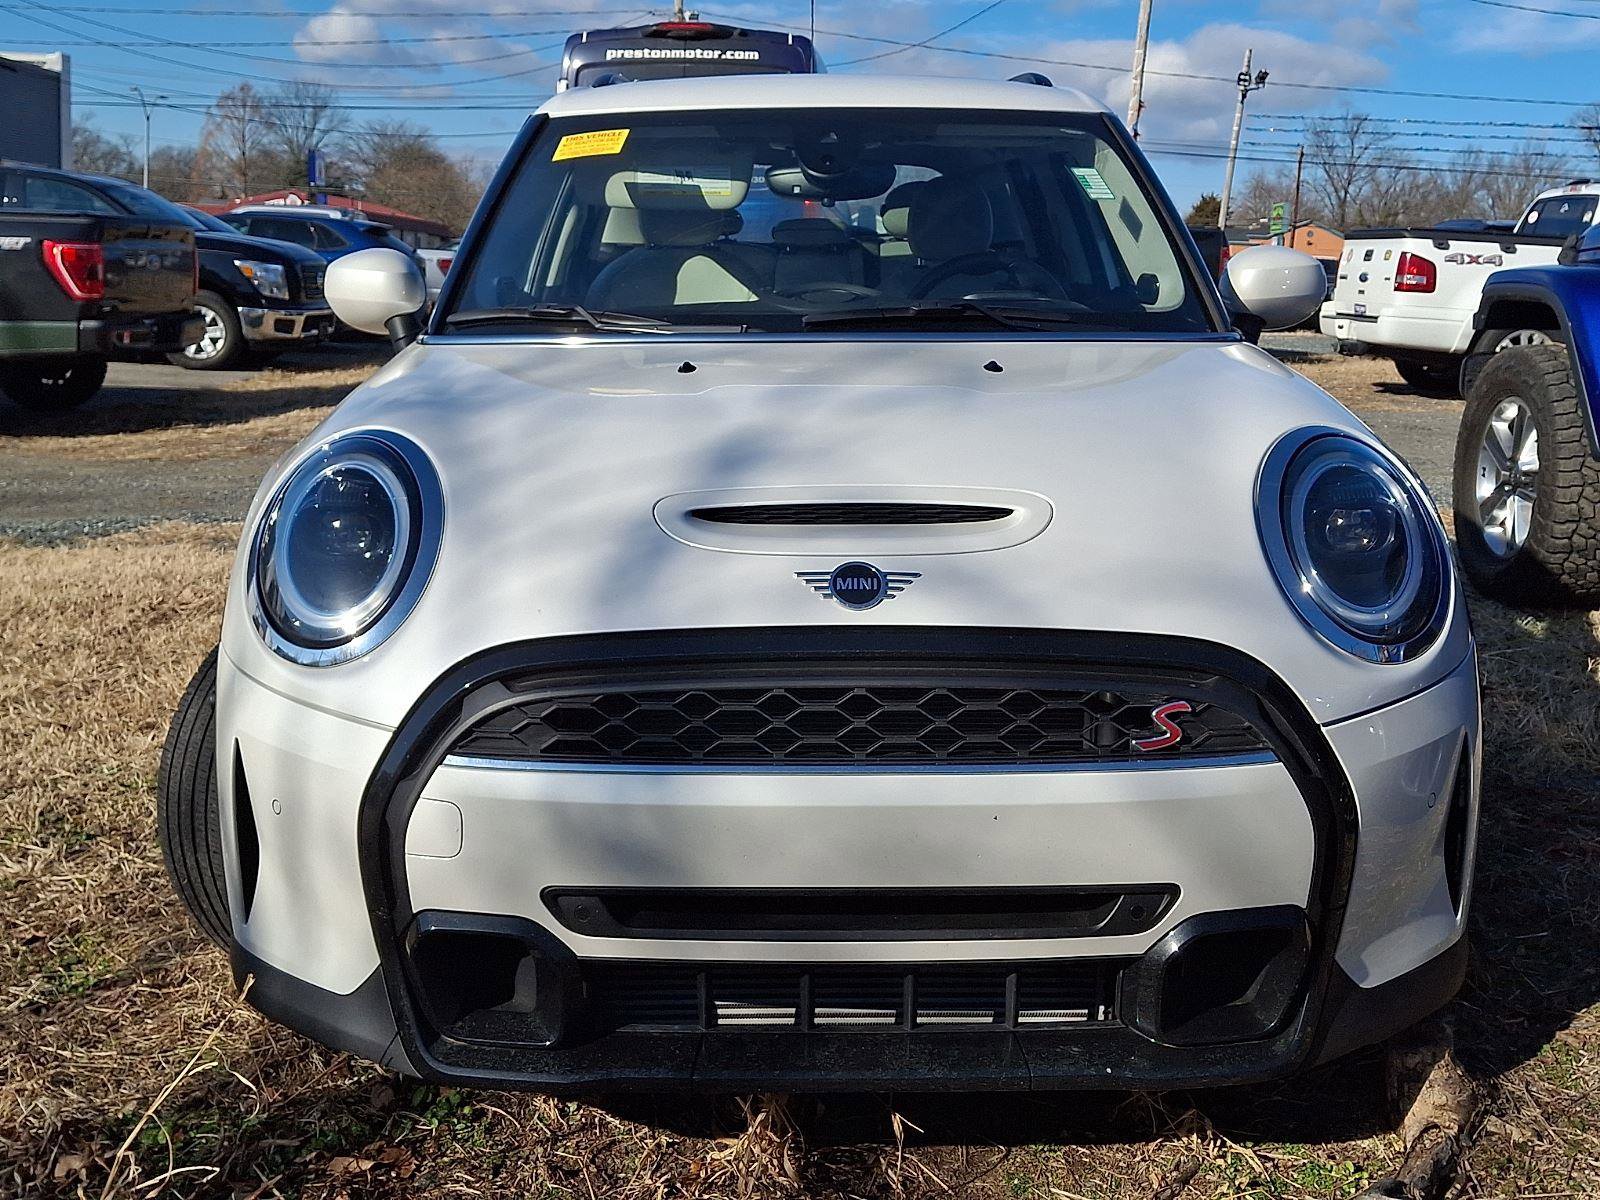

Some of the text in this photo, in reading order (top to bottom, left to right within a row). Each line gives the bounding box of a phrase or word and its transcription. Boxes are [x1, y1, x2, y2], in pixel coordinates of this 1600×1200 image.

[605, 49, 760, 61] prestonmotor.com
[565, 131, 623, 143] THIS VEHICLE
[836, 577, 878, 590] MINI
[1131, 700, 1192, 752] S
